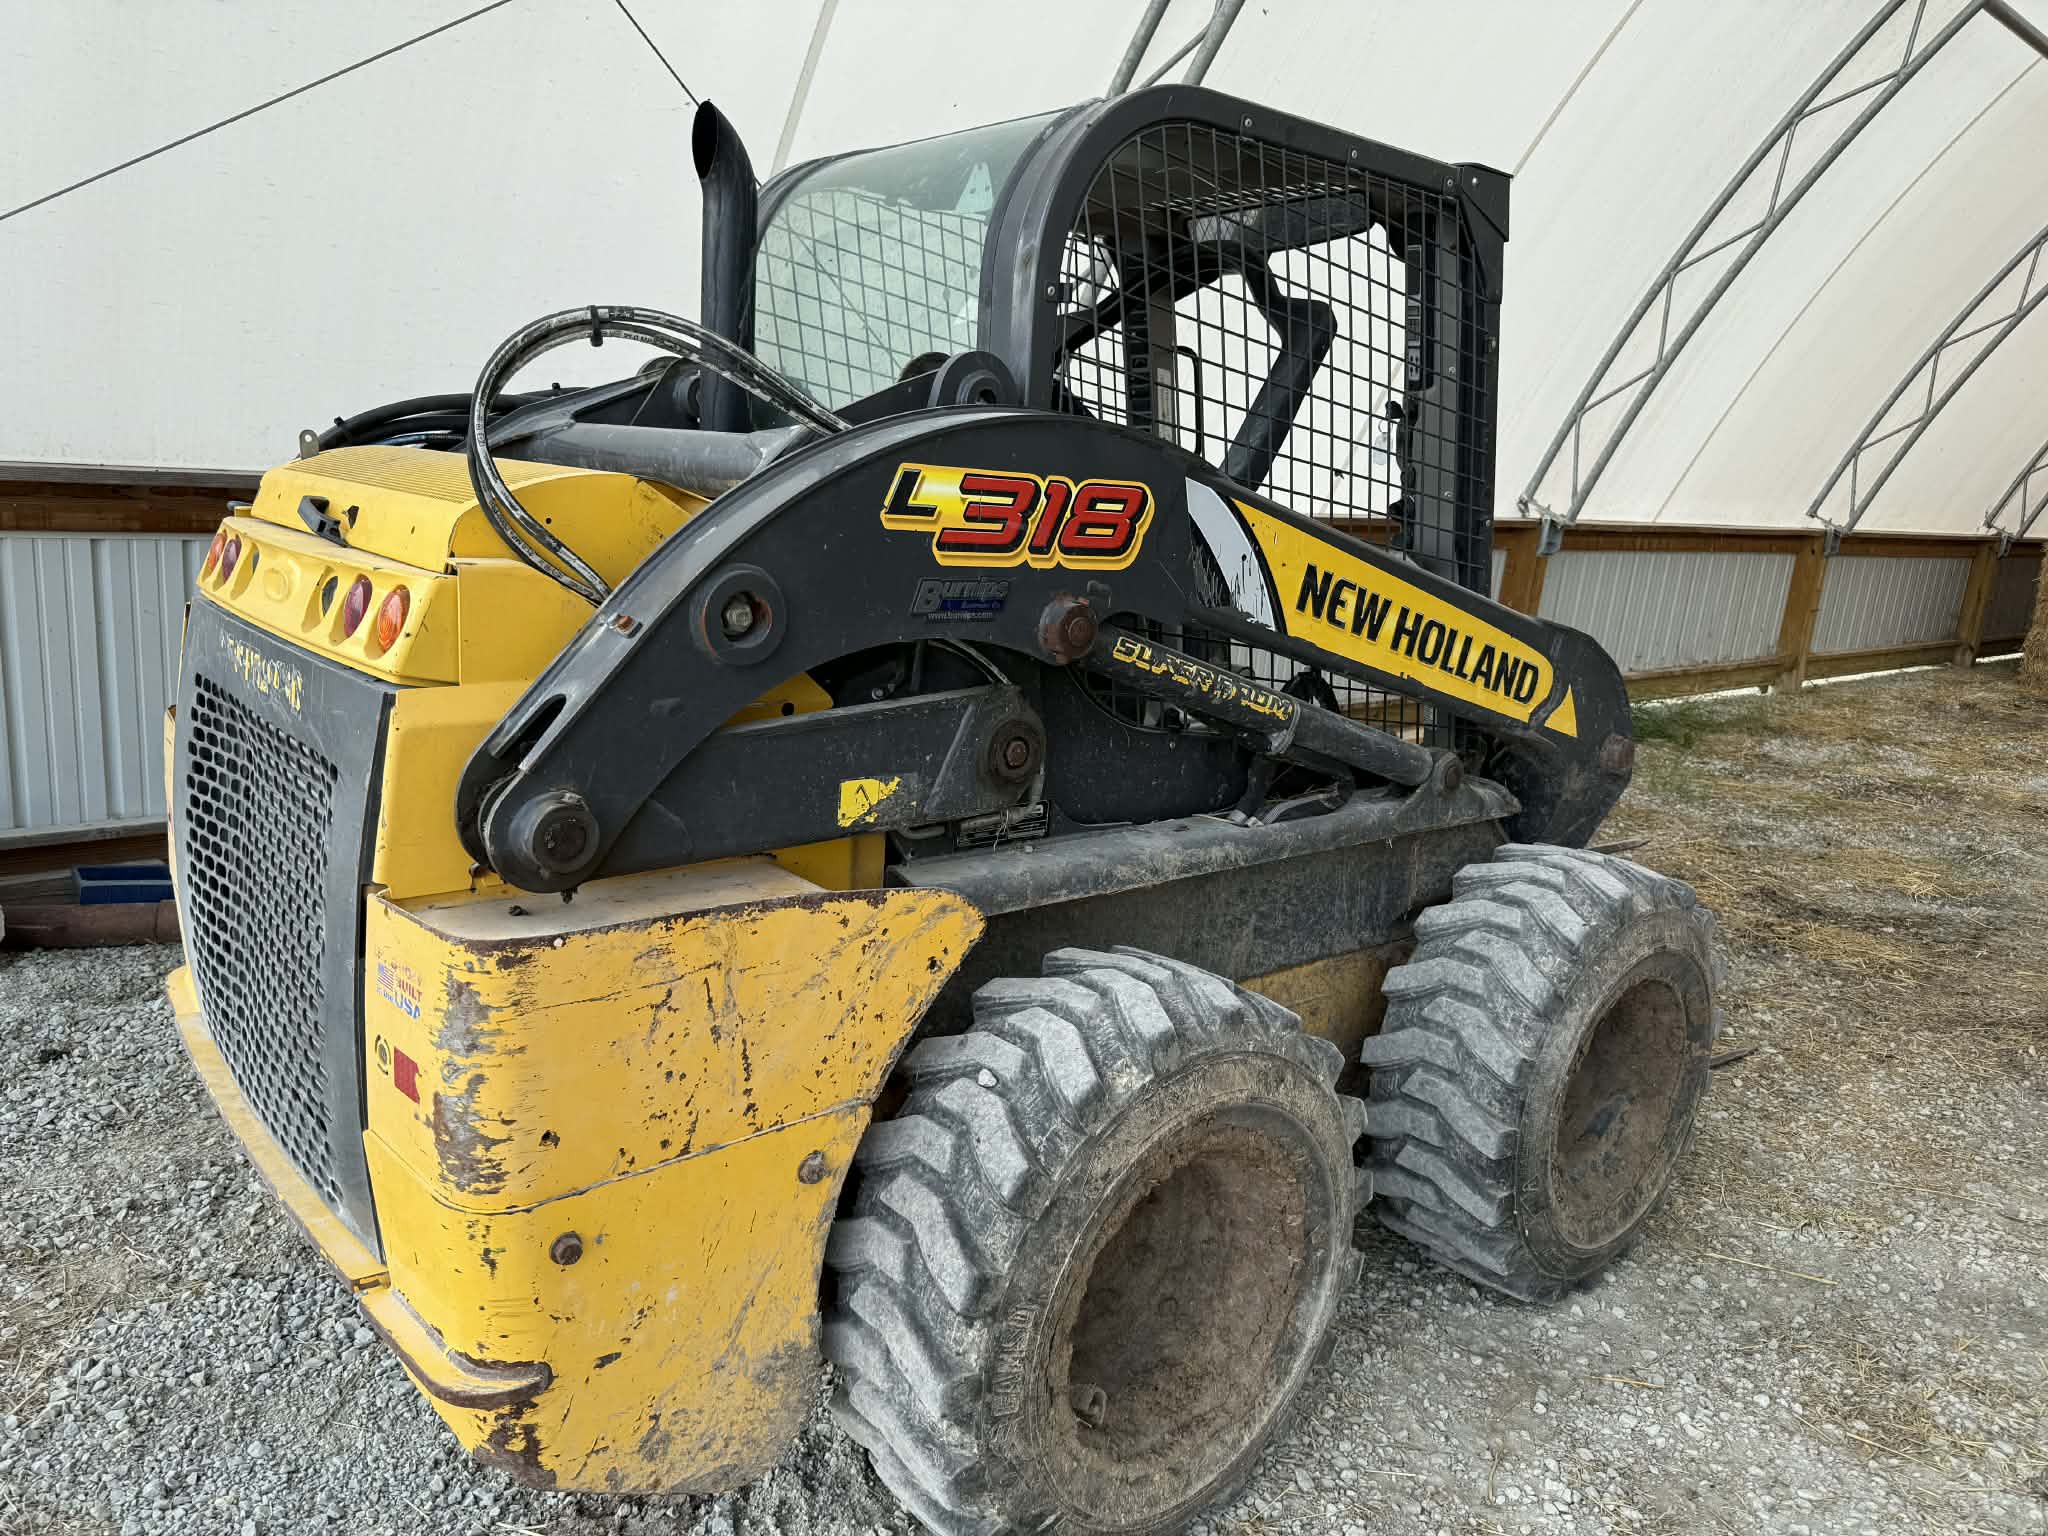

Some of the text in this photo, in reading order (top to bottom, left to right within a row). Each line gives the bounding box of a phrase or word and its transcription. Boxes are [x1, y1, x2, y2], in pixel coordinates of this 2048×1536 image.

[881, 463, 1154, 569] L318
[1296, 562, 1540, 705] NEW HOLLAND
[395, 991, 421, 1019] USA
